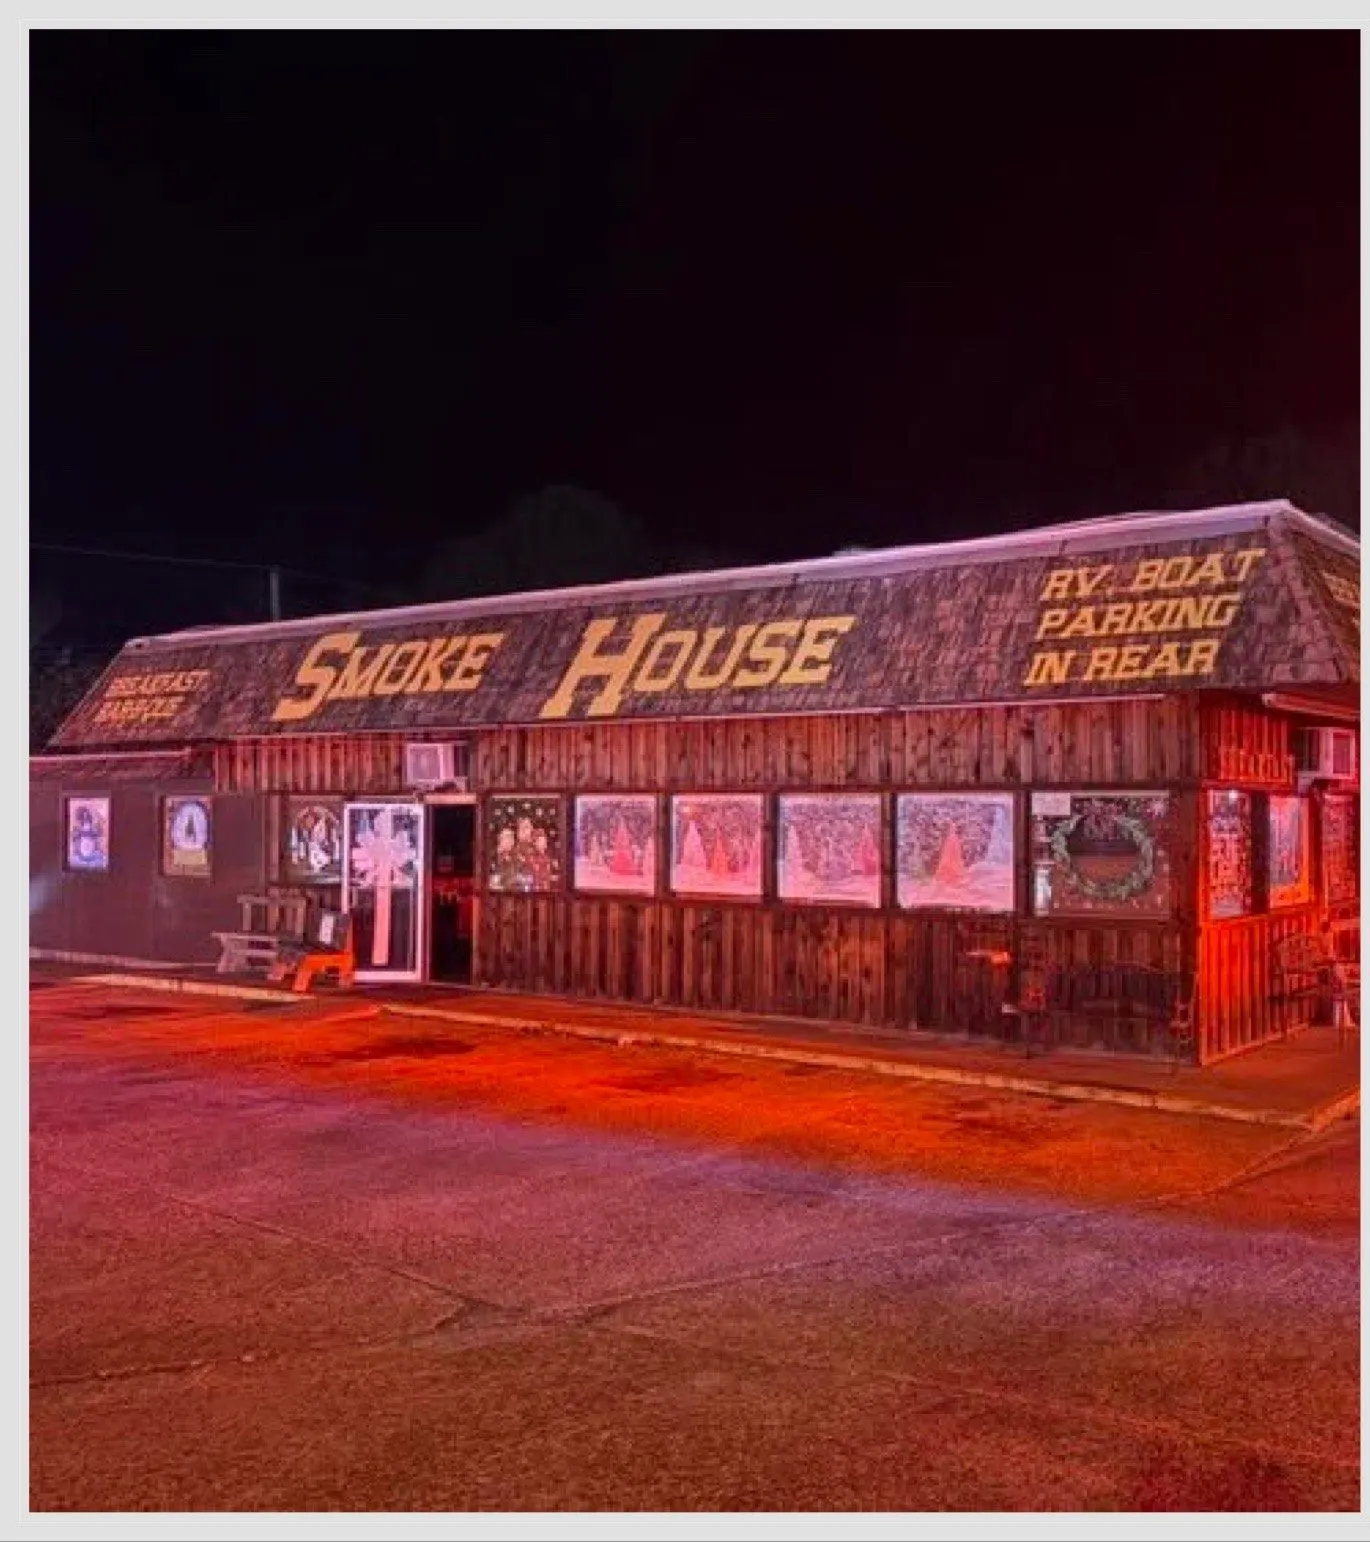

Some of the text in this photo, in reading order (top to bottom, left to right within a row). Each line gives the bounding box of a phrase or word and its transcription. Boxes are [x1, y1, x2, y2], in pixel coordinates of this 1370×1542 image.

[1131, 547, 1266, 592] BOAT
[1035, 592, 1242, 640] PARKING
[272, 613, 856, 722] SMOKE HOUSE
[1024, 638, 1222, 687] IN REAR
